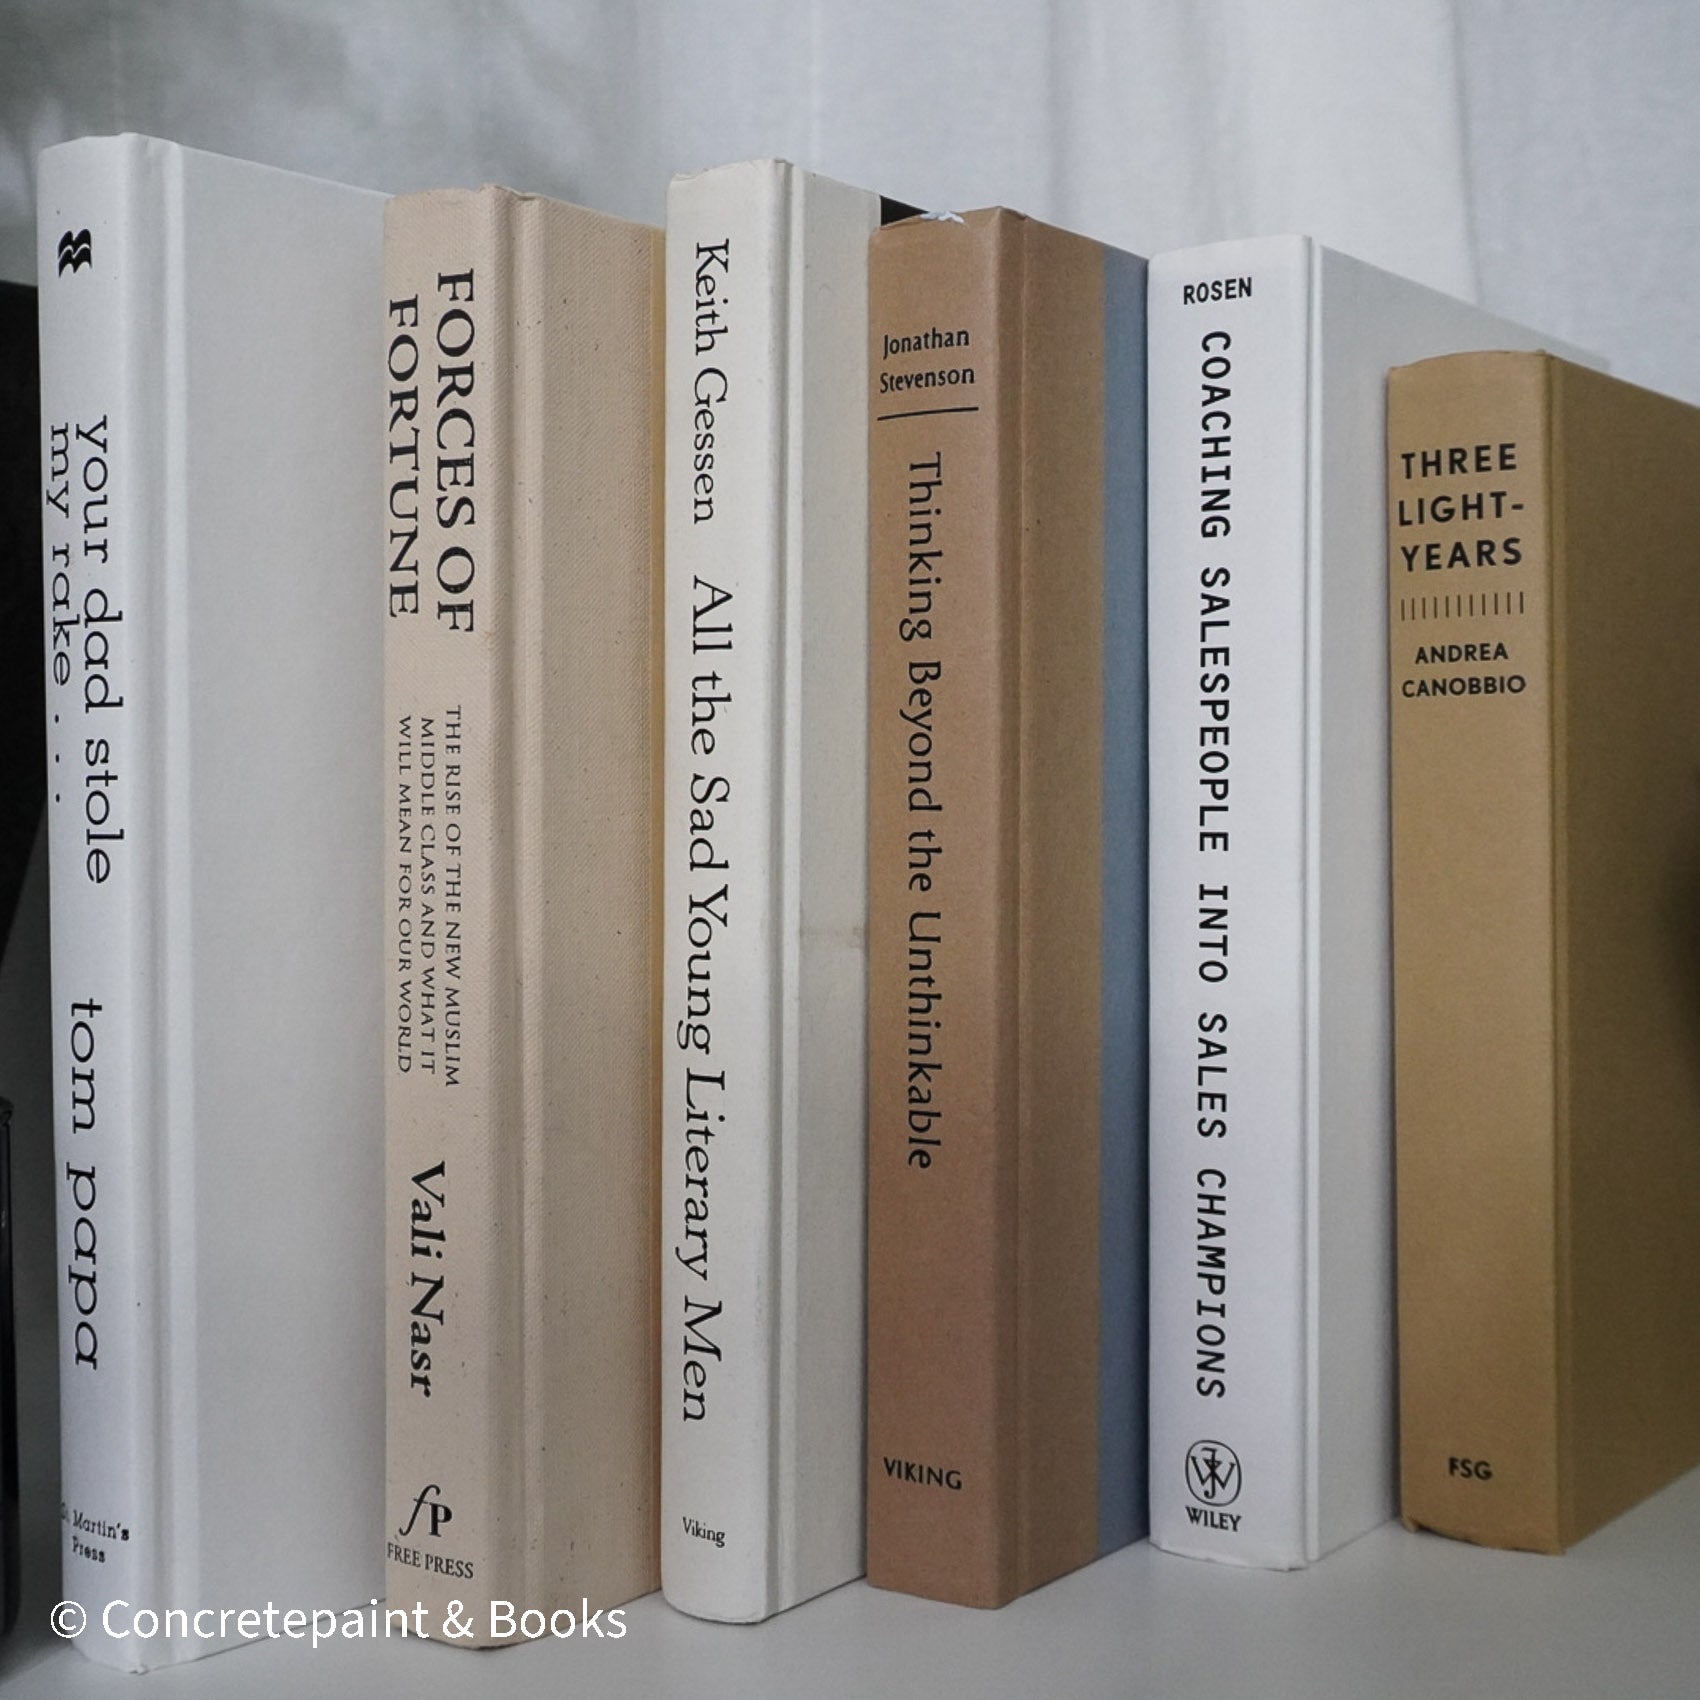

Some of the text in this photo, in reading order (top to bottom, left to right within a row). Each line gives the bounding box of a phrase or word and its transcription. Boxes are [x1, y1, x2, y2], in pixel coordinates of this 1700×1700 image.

[1183, 276, 1253, 306] ROSEN
[882, 326, 970, 361] Jonathan
[879, 367, 975, 394] Stevenson
[387, 293, 421, 618] FORTUNE
[435, 267, 476, 633] FORCES OF
[1400, 442, 1517, 480] THREE
[45, 422, 70, 519] my
[1398, 490, 1524, 527] LIGHT-
[1400, 536, 1522, 573] YEARS
[52, 542, 81, 687] rake
[75, 414, 125, 884] your dad stole
[1414, 642, 1509, 665] ANDREA
[1401, 674, 1527, 699] CANOBBIO
[898, 450, 944, 1169] Thinking Beyond the Unthinkable
[674, 238, 734, 1422] Keith Gessen All the Sad Young Literary Men
[1196, 330, 1232, 1399] COACHING SALESPEOPLE INTO SALES CHAMPIONS
[397, 715, 413, 1074] WILL MEAN FOR OUR WORLD
[420, 717, 436, 1075] MIDDLE CLASS AND WHAT IT
[444, 704, 462, 1087] THE RISE OF THE NEW MUSLIM
[65, 997, 103, 1371] tom papa
[410, 1160, 447, 1398] Vali Nasr
[883, 1456, 963, 1491] VIKING
[1448, 1456, 1493, 1481] FSG
[682, 1516, 726, 1549] Viking
[1185, 1505, 1241, 1532] WILEY
[72, 1535, 106, 1563] Press
[387, 1541, 474, 1580] FREE PRESS
